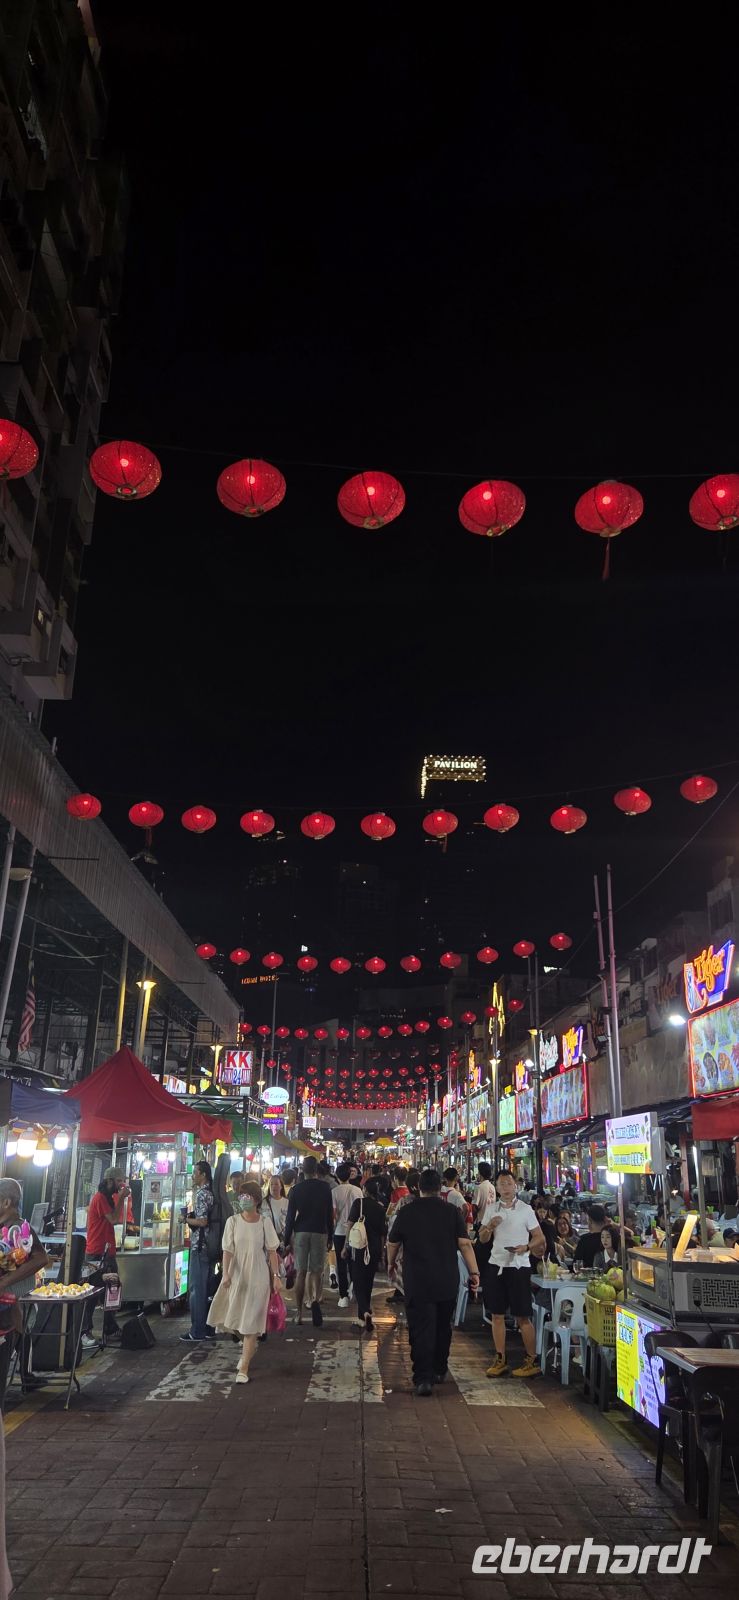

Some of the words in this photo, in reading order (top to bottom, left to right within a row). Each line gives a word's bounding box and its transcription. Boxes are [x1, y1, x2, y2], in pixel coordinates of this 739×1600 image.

[434, 760, 477, 768] PAVILION
[694, 945, 725, 992] Tiger
[226, 1051, 249, 1068] KK
